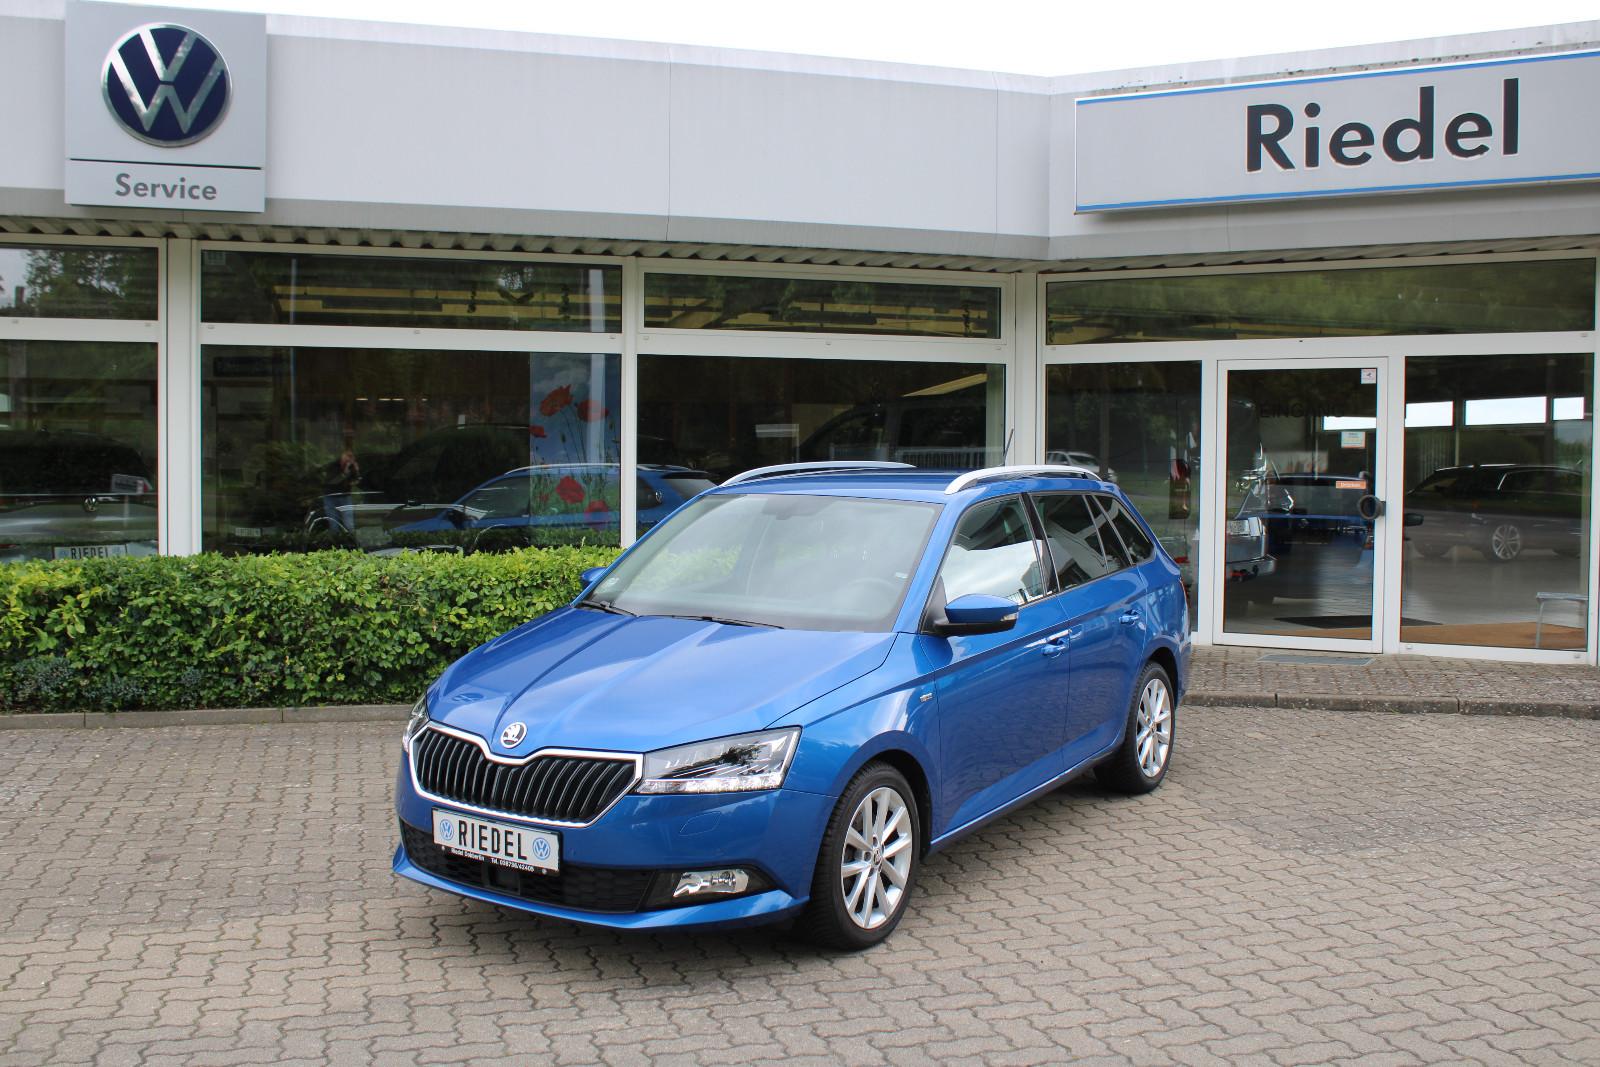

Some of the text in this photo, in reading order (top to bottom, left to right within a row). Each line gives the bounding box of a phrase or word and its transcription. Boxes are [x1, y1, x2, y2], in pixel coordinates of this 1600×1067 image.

[104, 24, 230, 142] VW
[1246, 78, 1519, 172] Riedel
[115, 173, 217, 200] Service
[1260, 403, 1344, 418] EINGANG
[458, 820, 528, 861] RIEDEL
